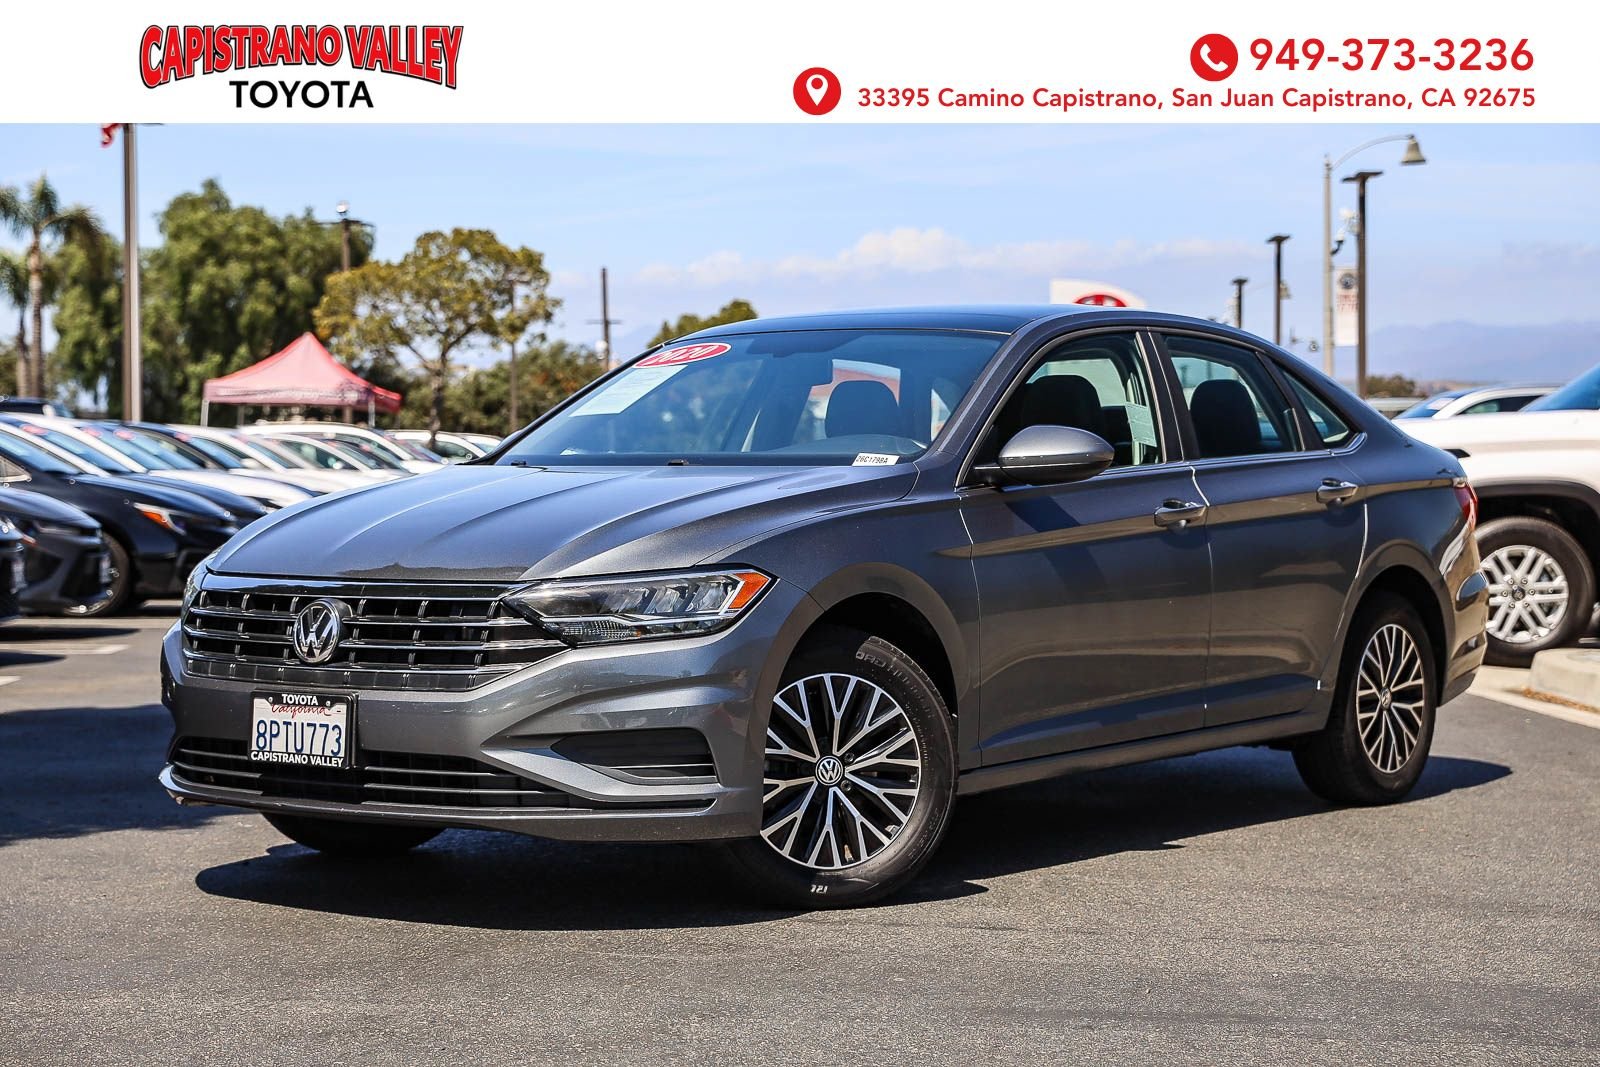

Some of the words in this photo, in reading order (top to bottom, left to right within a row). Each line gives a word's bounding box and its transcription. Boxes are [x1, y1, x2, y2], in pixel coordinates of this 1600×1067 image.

[281, 694, 319, 706] TOYOTA
[256, 719, 342, 757] 8PTU773
[250, 751, 308, 765] CAPISTRANO
[309, 755, 344, 768] VALLEY
